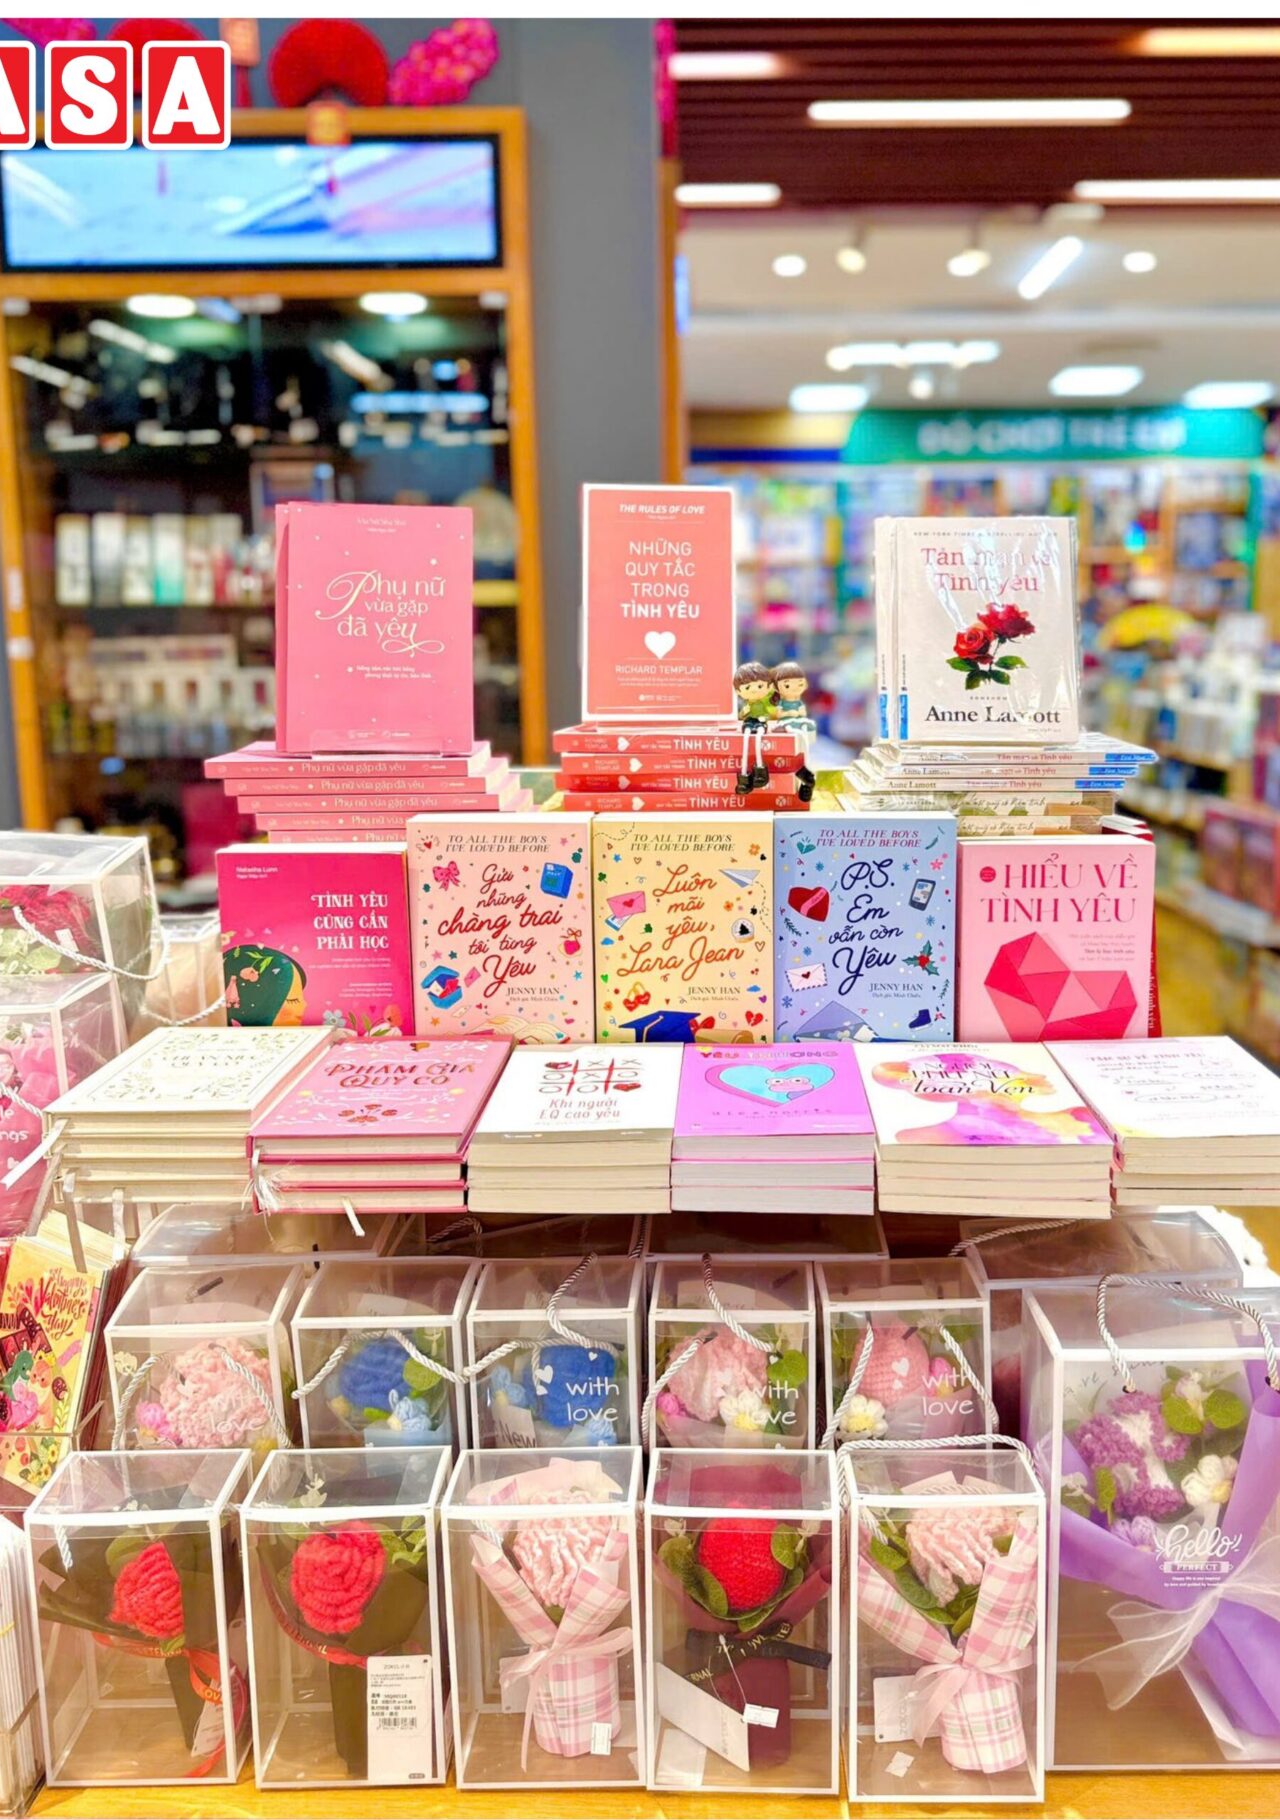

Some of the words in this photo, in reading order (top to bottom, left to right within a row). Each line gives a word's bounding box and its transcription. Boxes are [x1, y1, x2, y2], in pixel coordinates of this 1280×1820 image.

[619, 504, 636, 512] THE
[638, 504, 667, 513] RULES
[668, 505, 680, 514] OF
[682, 505, 705, 514] LOVE
[629, 538, 692, 556] NHỮNG
[625, 561, 659, 576] QUY
[663, 556, 695, 576] TẮC
[315, 570, 406, 620] Phụ
[415, 577, 446, 597] nữ
[631, 582, 689, 598] TRONG
[365, 598, 394, 613] vừa
[397, 599, 429, 617] gặp
[621, 599, 662, 618] TÌNH
[667, 600, 700, 619] YÊU
[336, 615, 367, 638] đã
[374, 618, 445, 658] yêu
[615, 665, 656, 674] RICHARD
[659, 665, 703, 674] TEMPLAR
[924, 705, 978, 722] Anne
[673, 737, 703, 750] TÌNH
[706, 736, 729, 750] YÊU
[687, 755, 717, 769] TÌNH
[719, 755, 743, 769] YÊU
[673, 776, 704, 790] TÌNH
[705, 776, 728, 790] YÊU
[689, 796, 719, 809] TÌNH
[721, 796, 746, 808] YÊU
[448, 835, 463, 843] TO
[465, 835, 487, 843] ALL
[490, 835, 515, 843] THE
[519, 835, 547, 843] BOYS
[633, 834, 648, 842] TO
[652, 834, 672, 842] ALL
[677, 834, 700, 842] THE
[704, 834, 732, 842] BOYS
[816, 838, 836, 847] I'VE
[840, 838, 876, 847] LOVED
[879, 838, 922, 847] BEFORE
[820, 829, 834, 838] TO
[837, 830, 859, 838] ALL
[864, 830, 888, 838] THE
[891, 830, 919, 838] BOYS
[469, 844, 505, 852] LOVED
[508, 844, 550, 852] BEFORE
[654, 843, 690, 851] LOVED
[693, 843, 736, 851] BEFORE
[479, 863, 514, 894] Gửi
[840, 858, 895, 890] P.S.
[1004, 852, 1083, 888] HIỂU
[1094, 853, 1138, 888] VỀ
[652, 864, 718, 897] Luôn
[311, 890, 354, 908] TÌNH
[359, 890, 389, 908] YÊU
[476, 889, 527, 910] những
[667, 896, 705, 914] mãi
[846, 893, 890, 923] Em
[980, 892, 1059, 922] TÌNH
[1070, 892, 1136, 923] YÊU
[313, 914, 354, 929] CŨNG
[359, 910, 389, 929] CẦN
[437, 906, 512, 939] chàng
[519, 903, 564, 928] trai
[316, 933, 354, 950] PHẢI
[360, 935, 389, 952] HỌC
[828, 925, 865, 944] vẫn
[870, 924, 904, 940] còn
[468, 938, 491, 955] tôi
[499, 934, 538, 954] từng
[617, 942, 684, 977] Lara
[681, 935, 745, 981] Jean
[482, 954, 536, 998] Yêu
[832, 945, 897, 996] Yêu
[506, 987, 536, 996] JENNY
[539, 987, 560, 995] HAN
[688, 986, 718, 995] JENNY
[720, 986, 741, 994] HAN
[869, 983, 899, 992] JENNY
[902, 983, 923, 991] HAN
[549, 1098, 573, 1109] Khi
[577, 1097, 619, 1110] người
[564, 1111, 591, 1119] cao
[596, 1107, 620, 1120] yêu
[566, 1376, 619, 1396] with
[566, 1402, 619, 1422] love
[922, 1396, 974, 1416] love
[1165, 1524, 1234, 1562] hello
